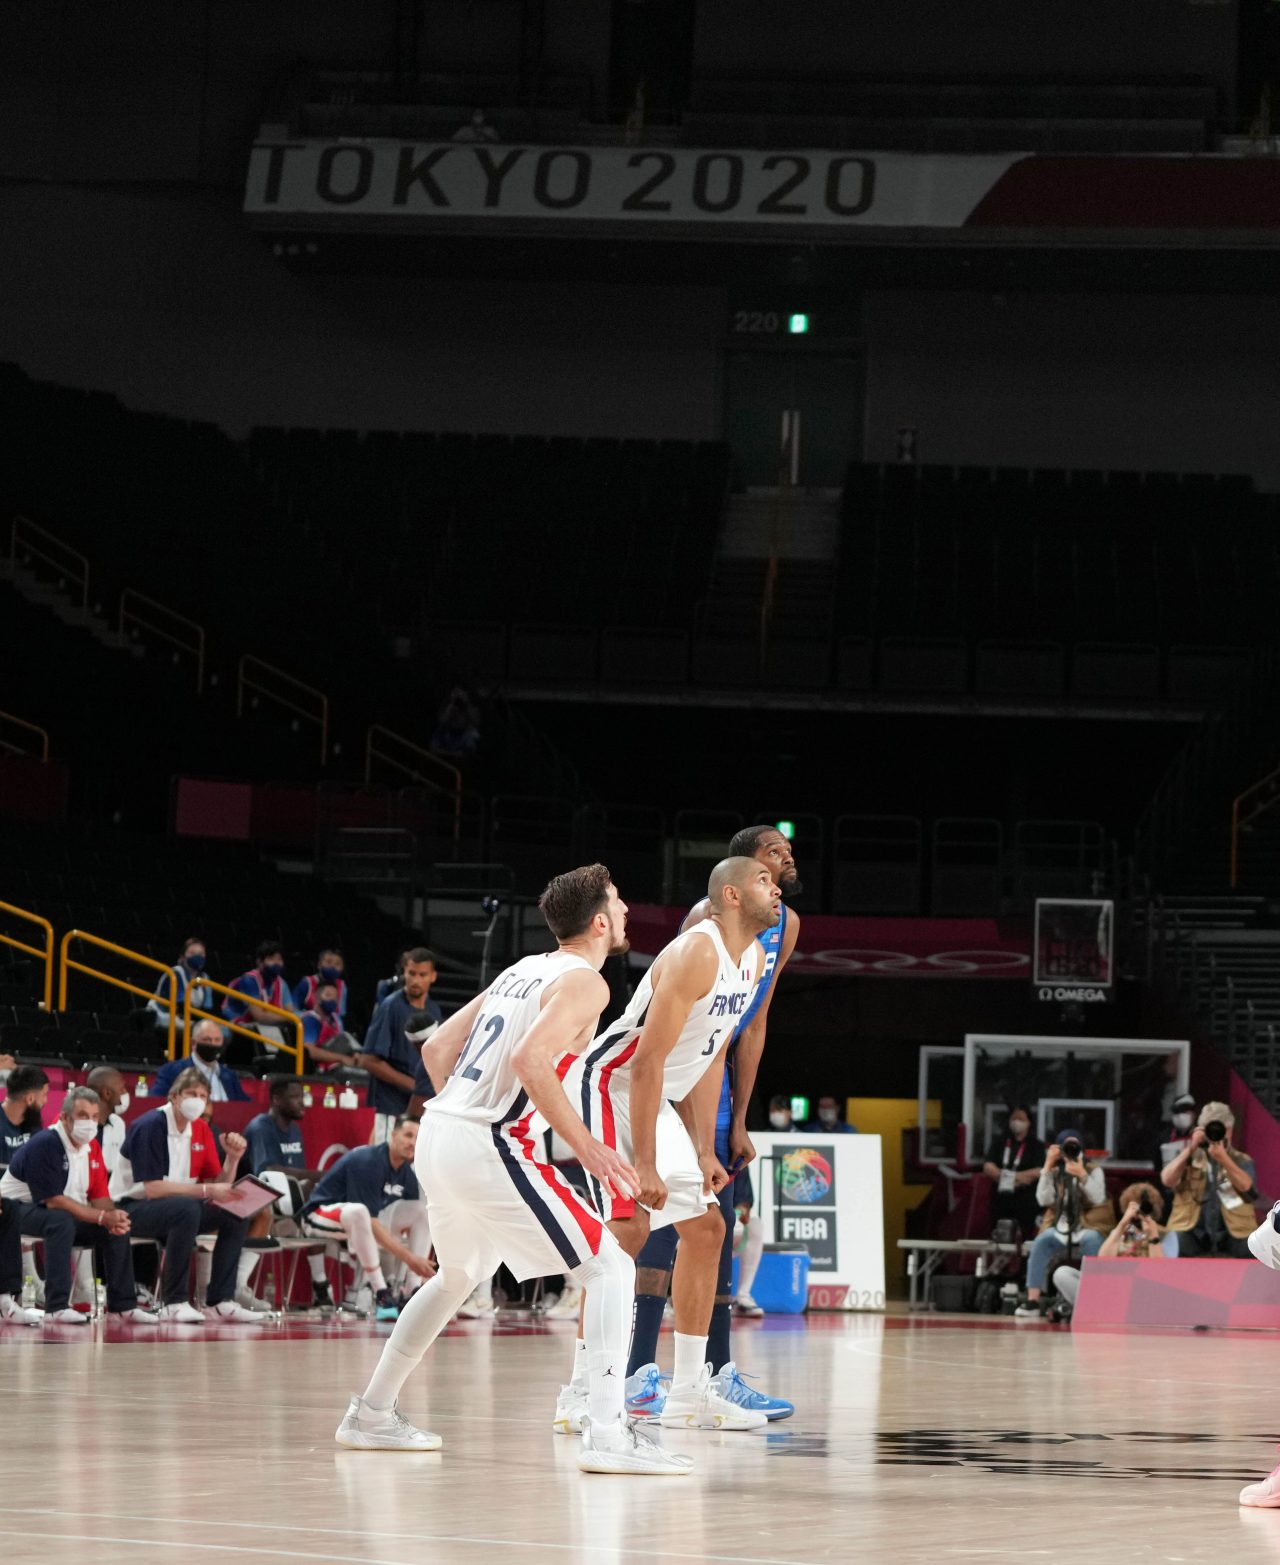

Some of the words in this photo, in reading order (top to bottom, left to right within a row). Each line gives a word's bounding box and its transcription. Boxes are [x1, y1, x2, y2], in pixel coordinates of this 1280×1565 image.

[251, 143, 593, 210] TOKYO
[621, 150, 878, 217] 2020
[734, 310, 779, 333] 220
[707, 992, 748, 1017] FRNCE
[1054, 987, 1107, 1003] OMEGA
[451, 1013, 505, 1083] 12
[701, 1028, 722, 1056] 5
[782, 1216, 829, 1241] FIBA
[835, 1288, 886, 1309] 2020
